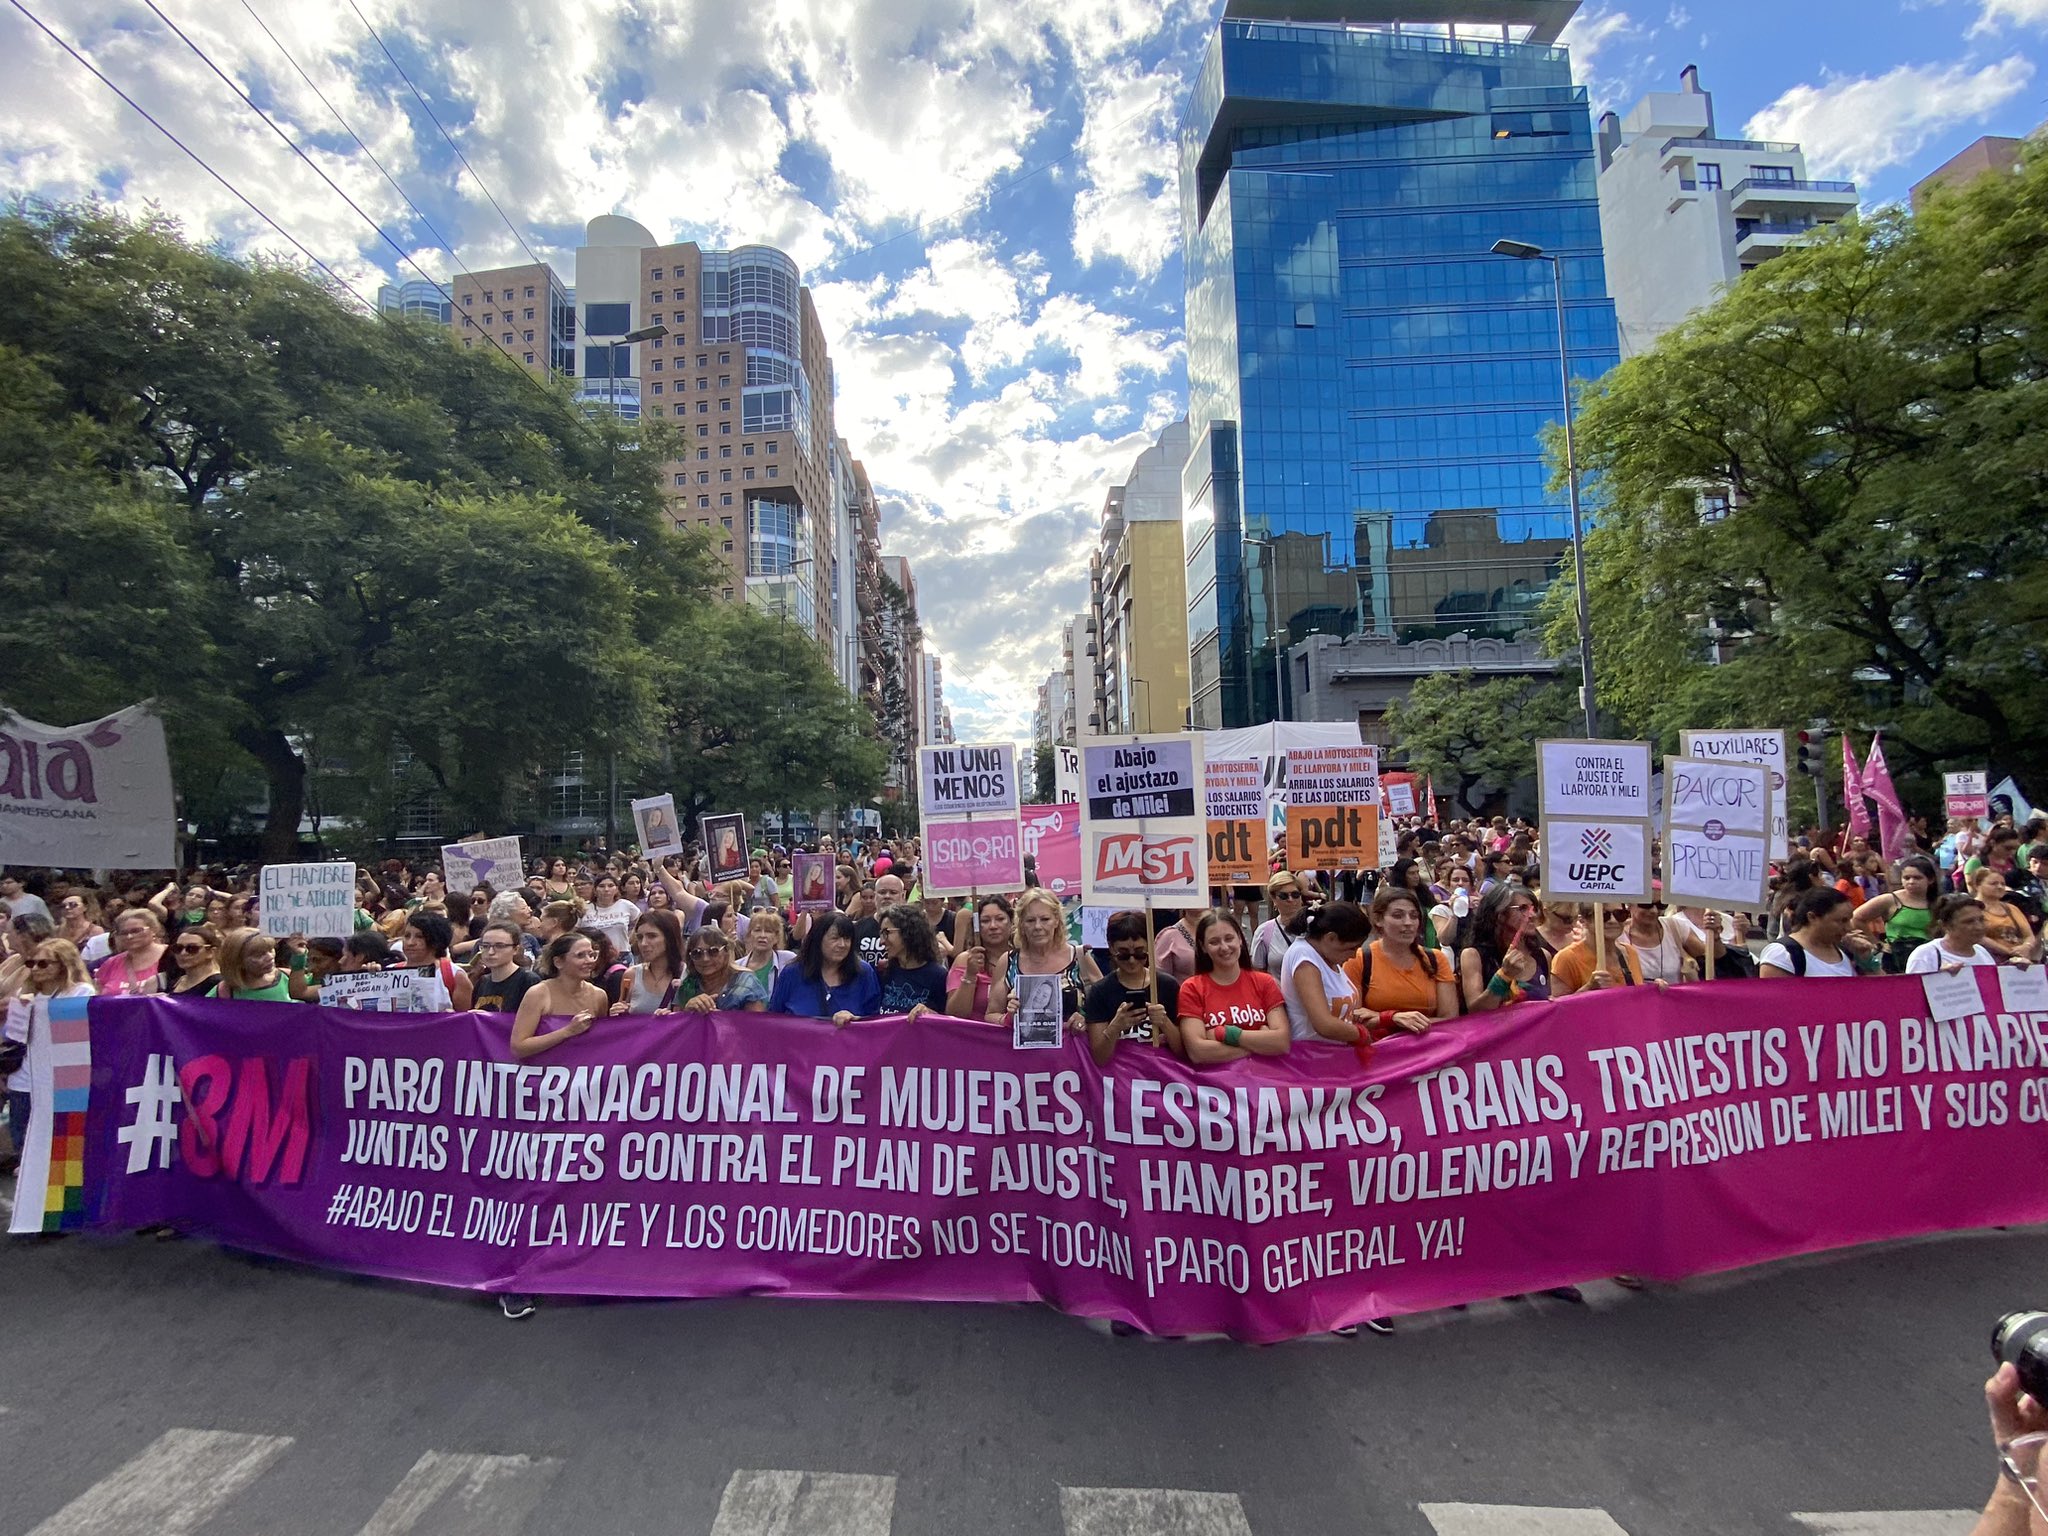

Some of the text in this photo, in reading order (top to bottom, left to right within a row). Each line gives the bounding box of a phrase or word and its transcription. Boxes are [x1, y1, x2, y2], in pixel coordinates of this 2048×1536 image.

[1114, 747, 1156, 768] Abajo
[1288, 751, 1312, 760] ABAJO
[1314, 750, 1324, 759] LA
[1325, 748, 1373, 759] MOTOSIERRA
[1693, 737, 1779, 758] AUXILIARES
[933, 749, 1002, 774] NI UNA
[1212, 763, 1259, 773] MOTOSIERRA
[1293, 762, 1370, 774] DE LLARYORA Y MILEI
[1575, 757, 1625, 770] CONTRA EL
[934, 774, 1005, 800] MENOS
[1098, 770, 1178, 793] el ajustazo
[1231, 778, 1236, 786] Y
[1237, 777, 1256, 786] MILEI
[1289, 777, 1375, 790] ARRIBA LOS SALARIOS
[1577, 771, 1623, 783] AJUSTE DE
[1957, 775, 1973, 783] ESI
[1208, 792, 1223, 802] LOS
[1224, 791, 1261, 802] SALARIOS
[1292, 792, 1303, 803] DE
[1305, 792, 1321, 803] LAS
[1324, 790, 1370, 802] DOCENTES
[1561, 784, 1639, 797] LLARYORA Y MILEI
[1672, 774, 1756, 808] PAICOR
[1113, 793, 1169, 818] de Milei
[1213, 804, 1258, 816] DOCENTES
[1301, 806, 1361, 858] pdt
[932, 835, 1015, 866] ISADORA
[1104, 840, 1196, 880] MST
[1568, 864, 1625, 881] UEPC
[1672, 843, 1760, 881] PRESENTE
[265, 866, 352, 890] EL HAMBRE
[1580, 882, 1616, 890] CAPITAL
[266, 894, 283, 912] NO
[288, 891, 304, 907] SE
[335, 975, 347, 983] LOS
[392, 975, 409, 989] NO
[1230, 1004, 1265, 1026] Rojas
[344, 1056, 444, 1114] PARO
[453, 1059, 798, 1123] INTERNACIONAL
[812, 1065, 866, 1124] DE
[879, 1066, 1093, 1143] MUJERES,
[1103, 1076, 1401, 1156] LESBIANAS,
[1412, 1055, 1583, 1136] TRANS,
[1588, 1028, 1788, 1113] TRAVESTIS
[1798, 1024, 1824, 1082] Y
[1836, 1019, 1888, 1079] NO
[118, 1054, 310, 1184] #8M
[340, 1119, 449, 1171] JUNTAS
[458, 1127, 478, 1173] Y
[480, 1130, 605, 1182] JUNTES
[618, 1131, 767, 1183] CONTRA
[779, 1135, 821, 1185] EL
[832, 1136, 919, 1193] PLAN
[932, 1143, 978, 1197] DE
[990, 1144, 1127, 1218] AJUSTE,
[1140, 1159, 1332, 1223] HAMBRE,
[1349, 1136, 1553, 1206] VIOLENCIA
[1564, 1130, 1589, 1179] Y
[1598, 1101, 1764, 1175] REPRESION
[1770, 1095, 1812, 1146] DE
[1818, 1086, 1903, 1139] MILEI
[1910, 1084, 1933, 1130] Y
[1945, 1080, 2008, 1129] SUS
[326, 1184, 1465, 1297] #ABAJO EL DNU! LA IVE Y LOS COMEDORES NO SE TOCAN ¡PARO GENERAL YA!
